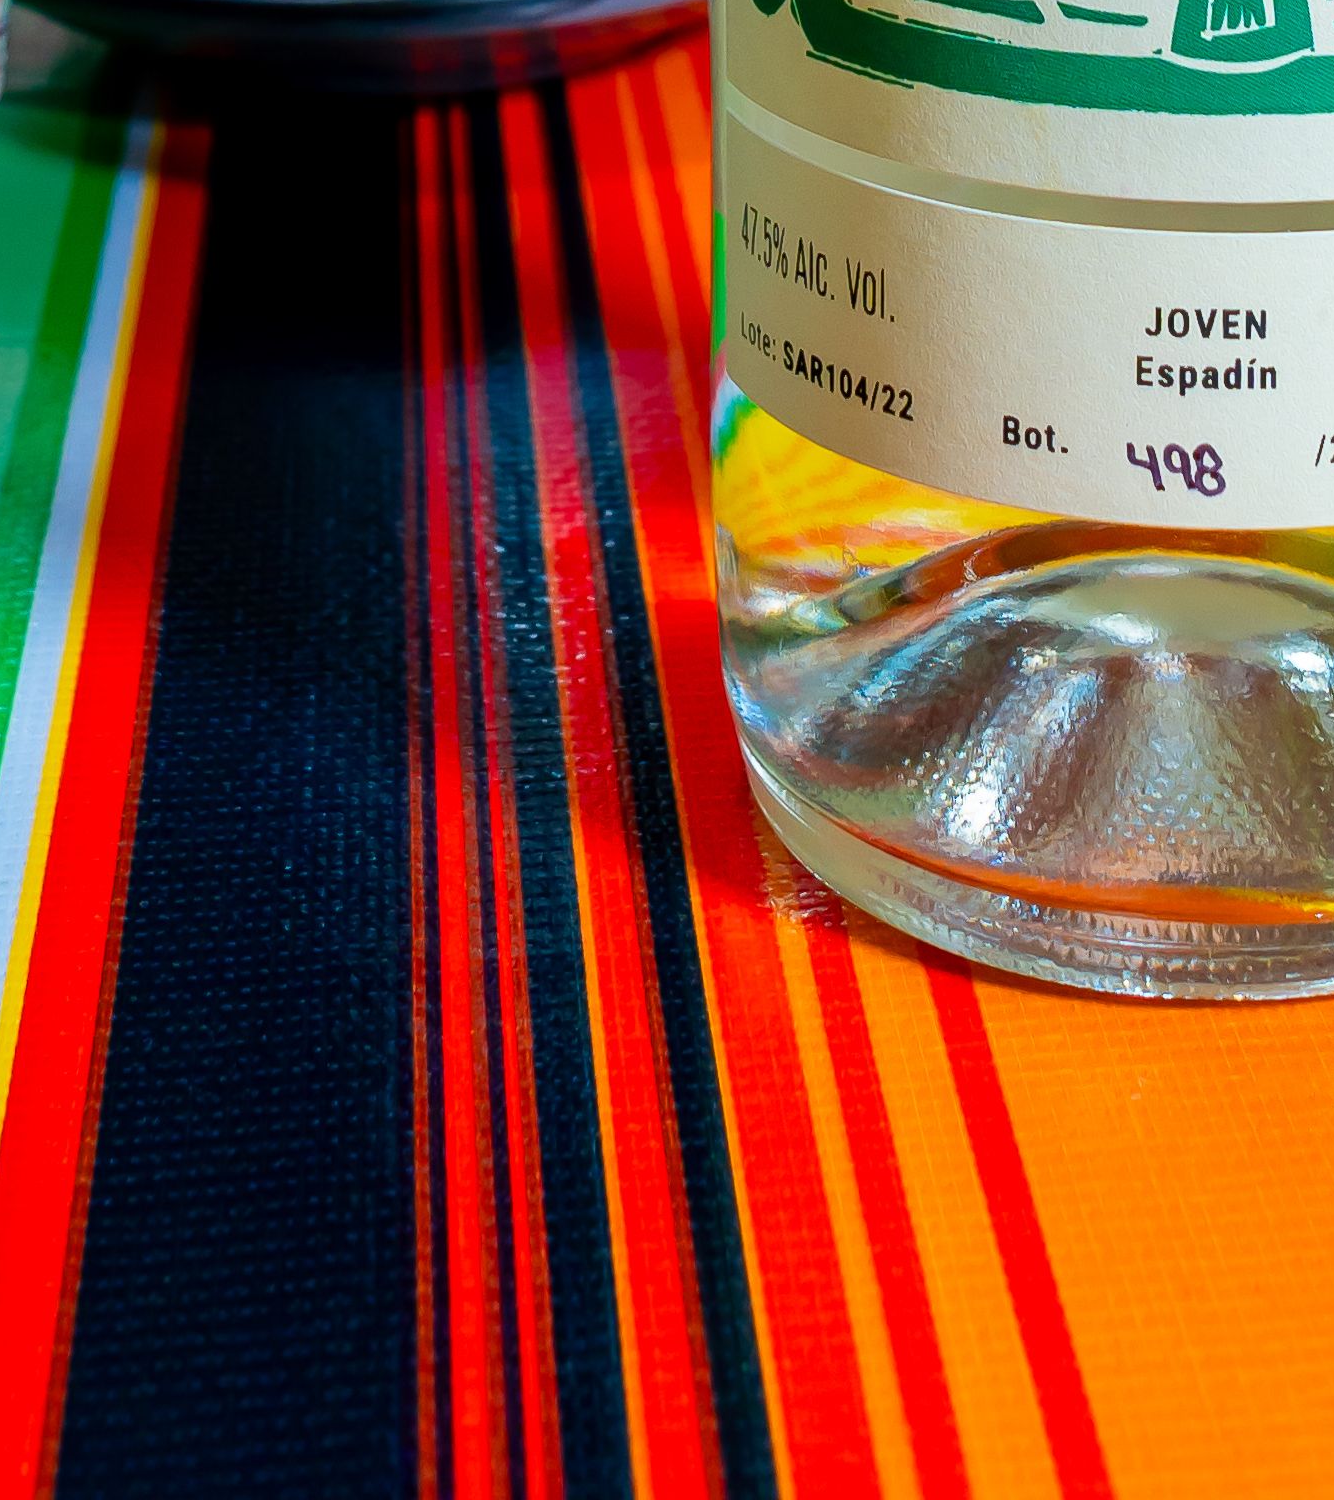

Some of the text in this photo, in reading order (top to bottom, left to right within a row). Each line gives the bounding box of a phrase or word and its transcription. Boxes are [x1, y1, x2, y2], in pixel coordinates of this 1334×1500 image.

[741, 201, 895, 323] 47.5% Alc. Vol.
[1144, 306, 1268, 341] JOVEN
[740, 310, 914, 422] Lote: SAR104/22
[1134, 354, 1279, 397] Espadín
[1001, 414, 1069, 455] Bot.
[1126, 441, 1227, 497] 498
